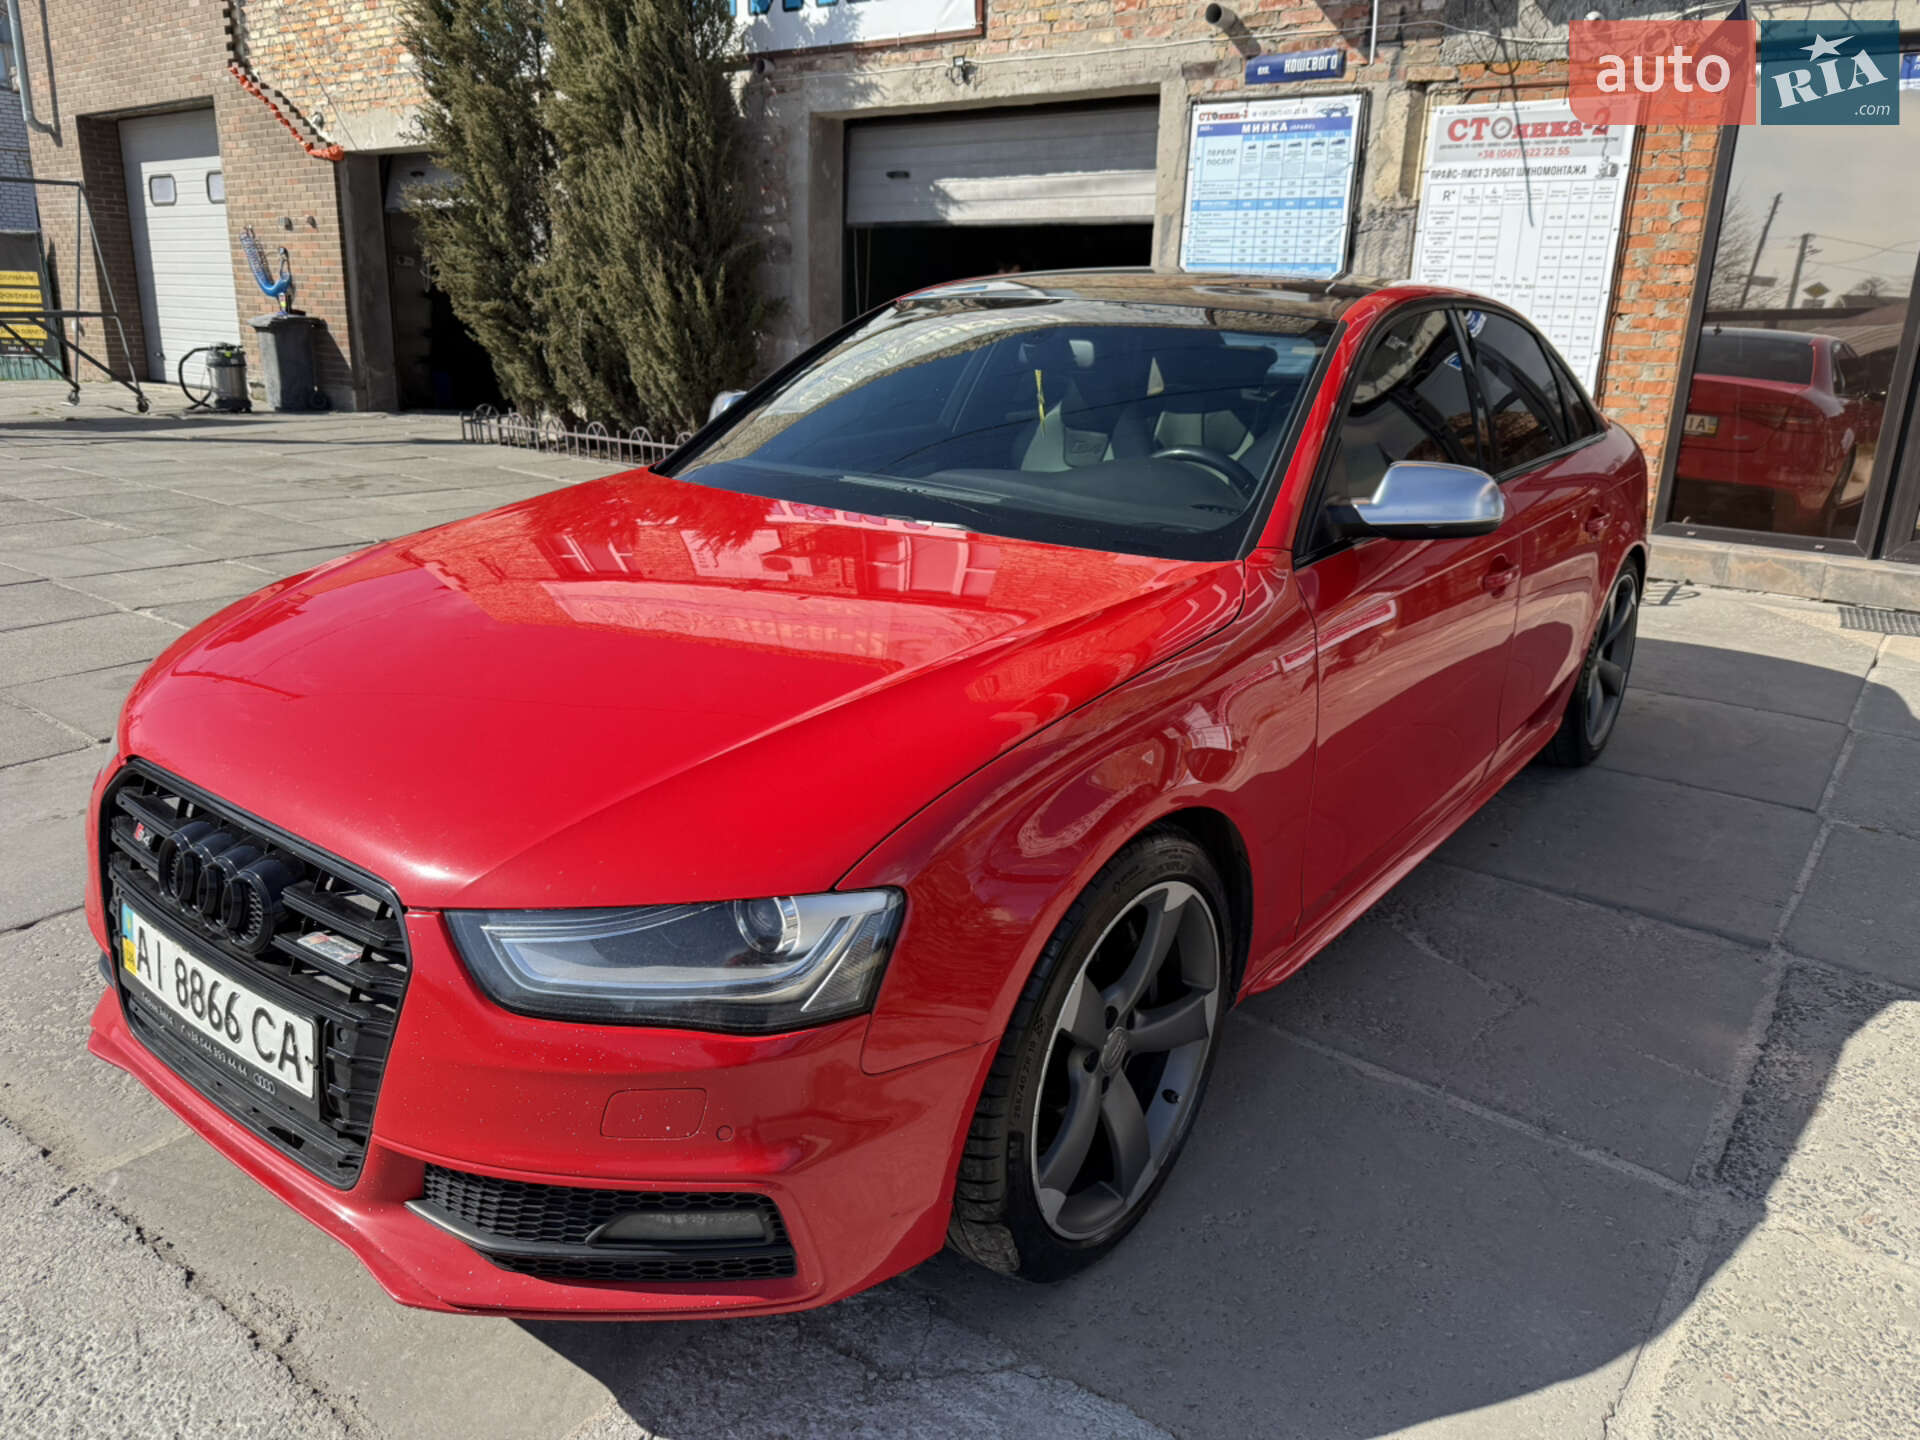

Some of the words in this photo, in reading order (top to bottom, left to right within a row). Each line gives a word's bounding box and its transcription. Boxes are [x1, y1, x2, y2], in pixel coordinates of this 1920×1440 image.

[1241, 121, 1288, 134] МИЙКА
[136, 926, 164, 991] AI
[174, 958, 243, 1044] 8866
[252, 1007, 304, 1084] CA
